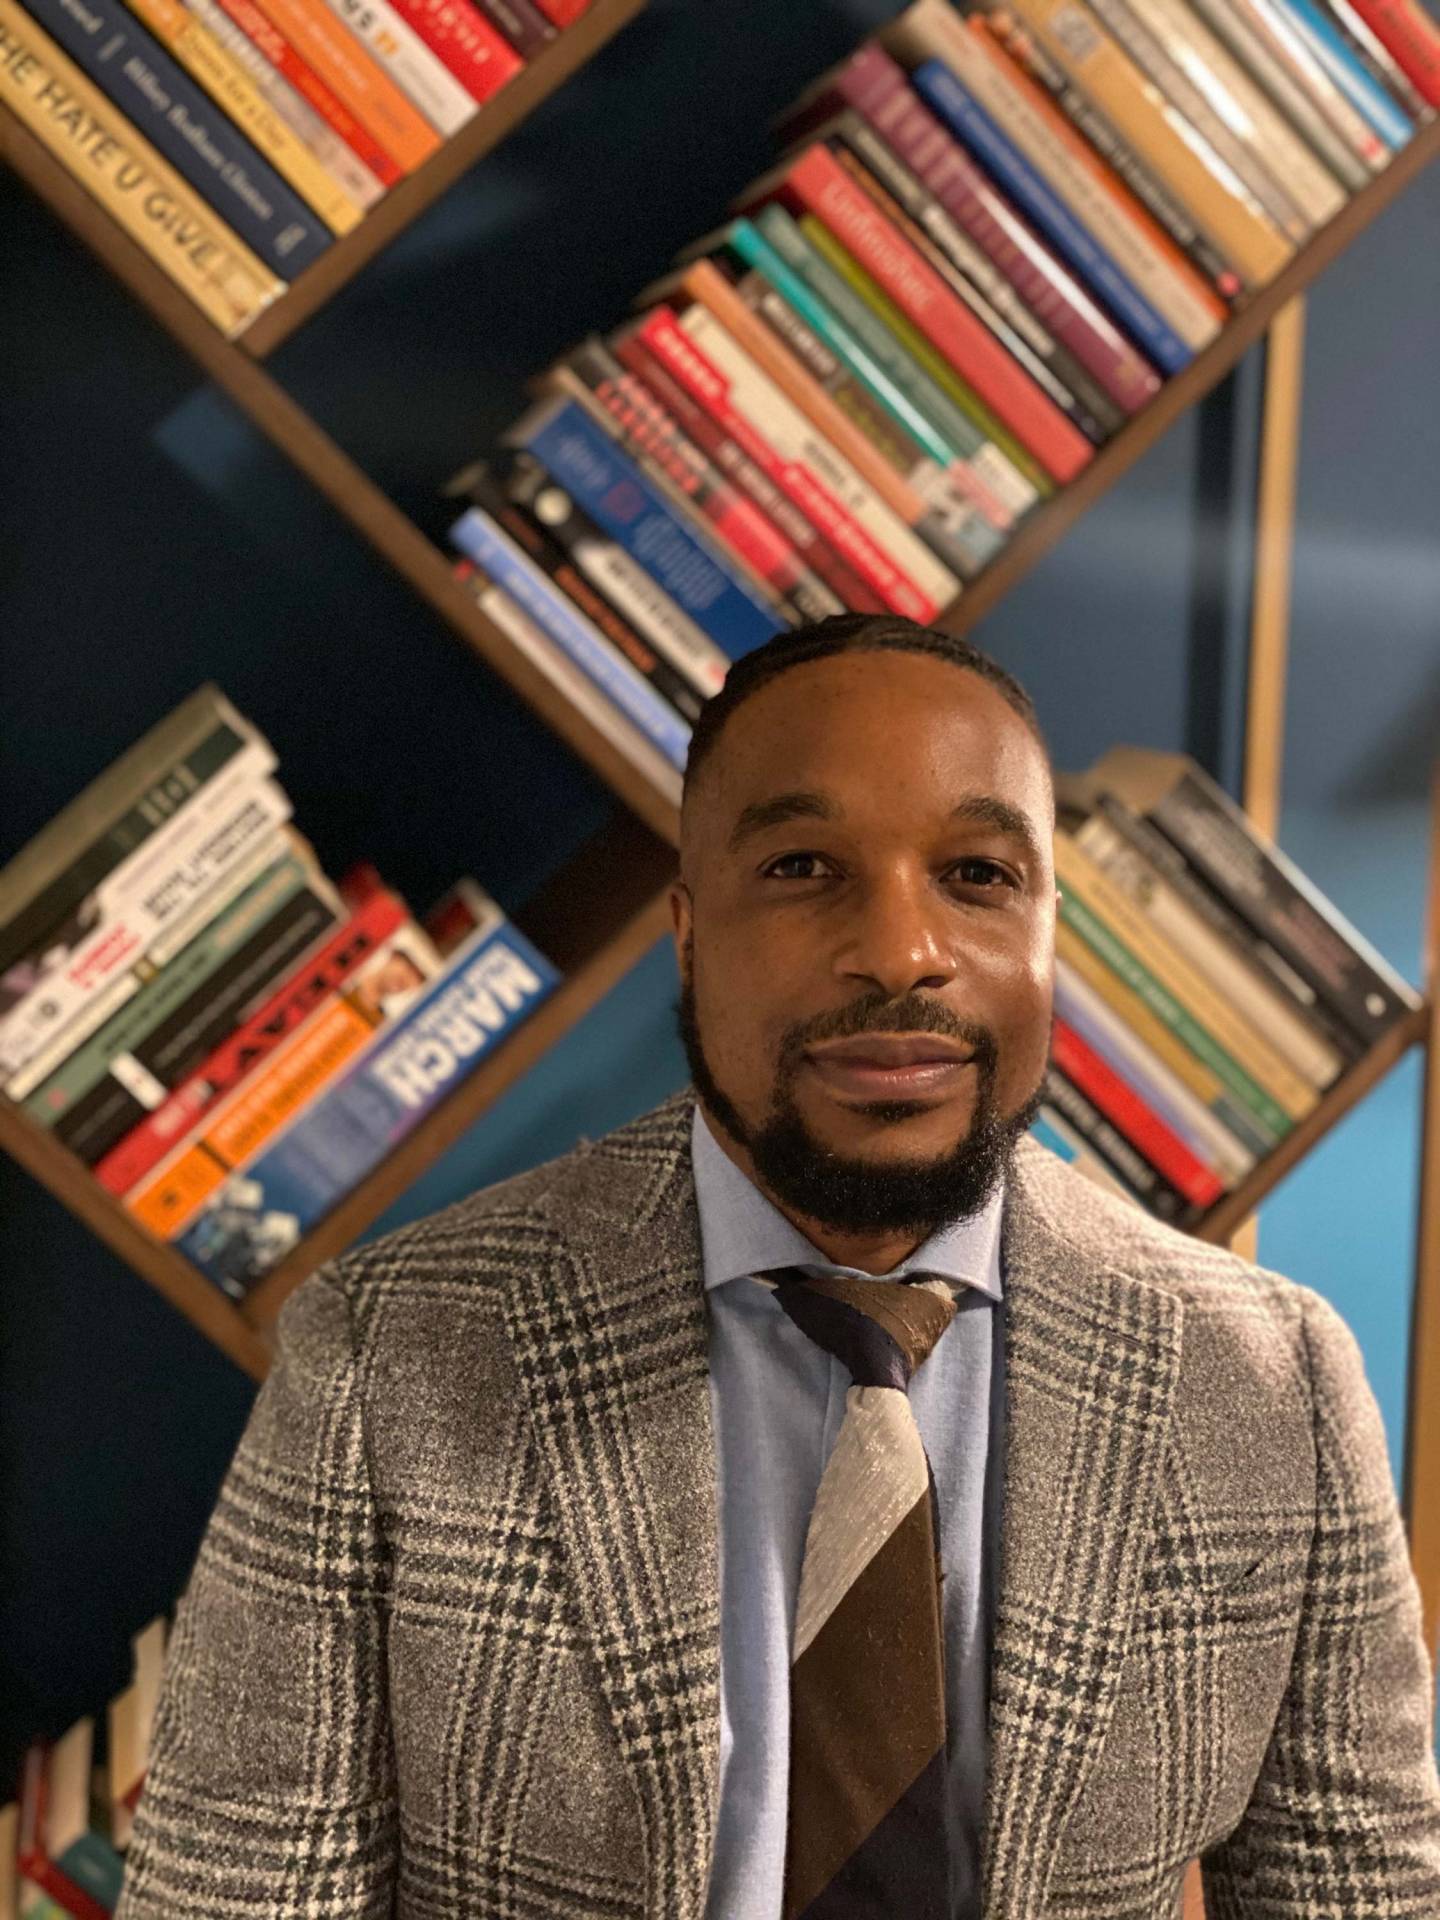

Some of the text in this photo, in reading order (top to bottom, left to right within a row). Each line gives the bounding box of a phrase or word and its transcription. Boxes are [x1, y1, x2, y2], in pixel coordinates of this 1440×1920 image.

[34, 79, 119, 166] HATE
[112, 160, 144, 193] U
[142, 189, 219, 268] GIVE
[374, 947, 544, 1110] MARCH
